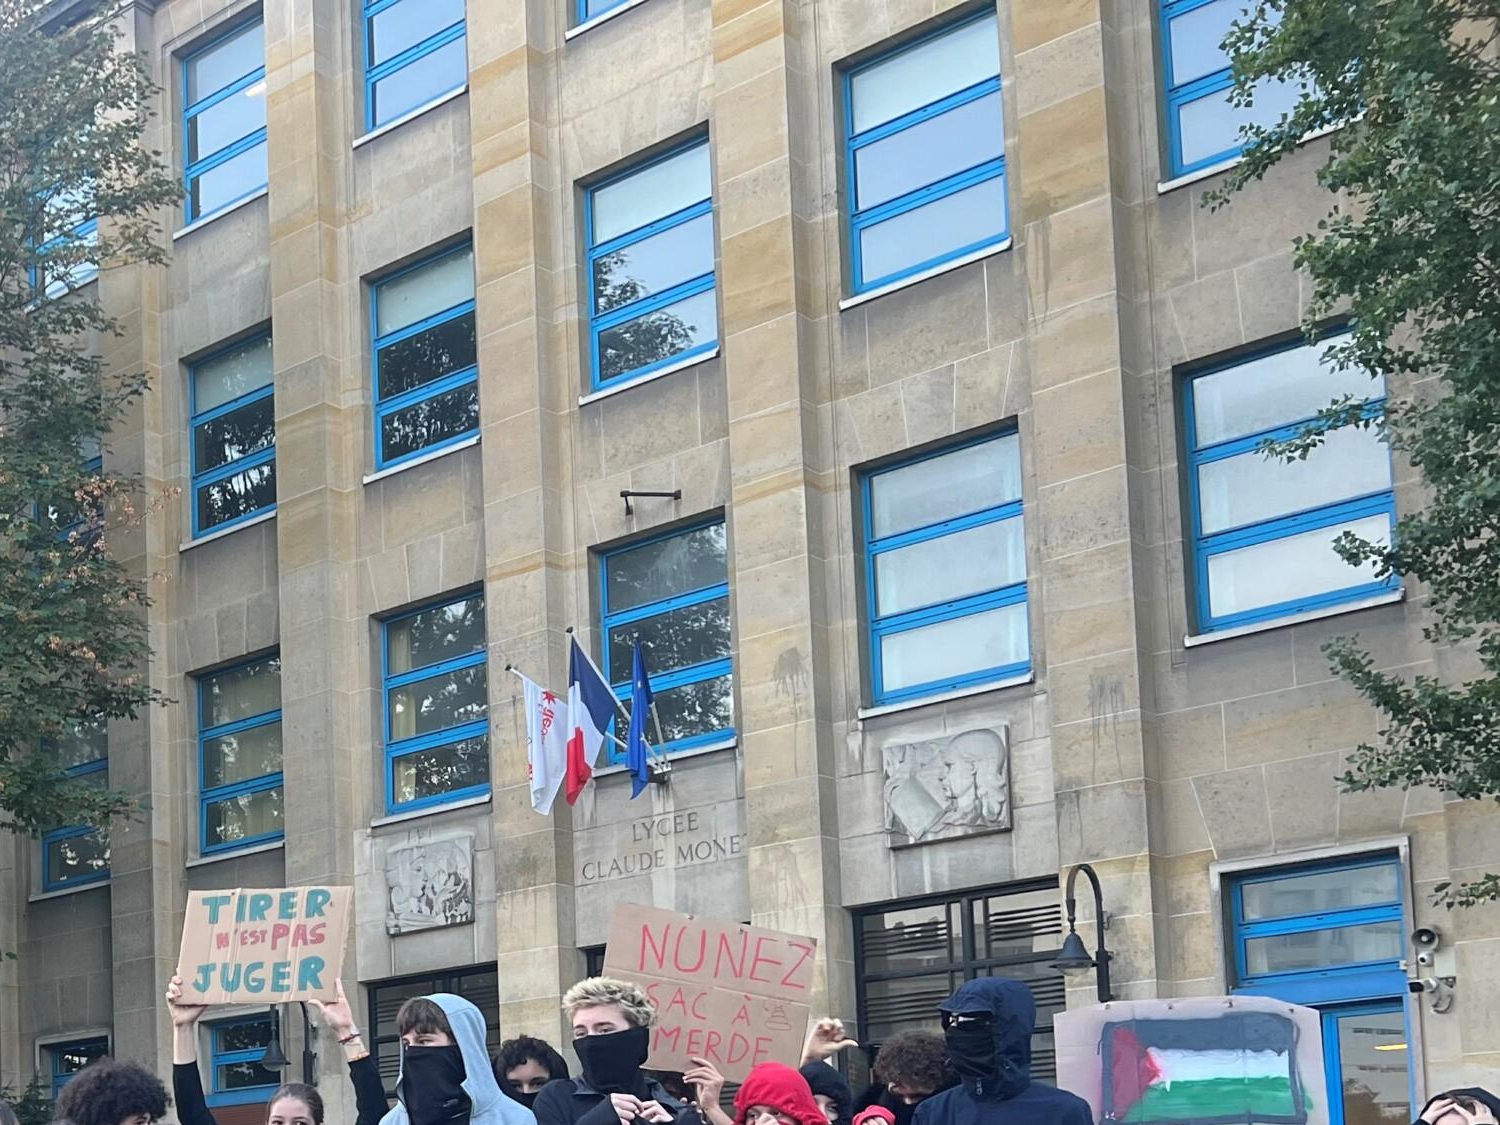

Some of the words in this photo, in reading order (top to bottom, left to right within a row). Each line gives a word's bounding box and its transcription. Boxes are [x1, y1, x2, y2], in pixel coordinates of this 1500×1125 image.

[633, 812, 699, 842] LYCEE
[582, 849, 665, 880] CLAUDE
[677, 833, 747, 864] MONE
[202, 888, 332, 924] TIRER
[271, 922, 327, 951] PAS
[192, 955, 326, 993] JUGER
[639, 924, 814, 989] NUNEZ
[646, 983, 708, 1020] SAC
[653, 1025, 773, 1067] MERDE
